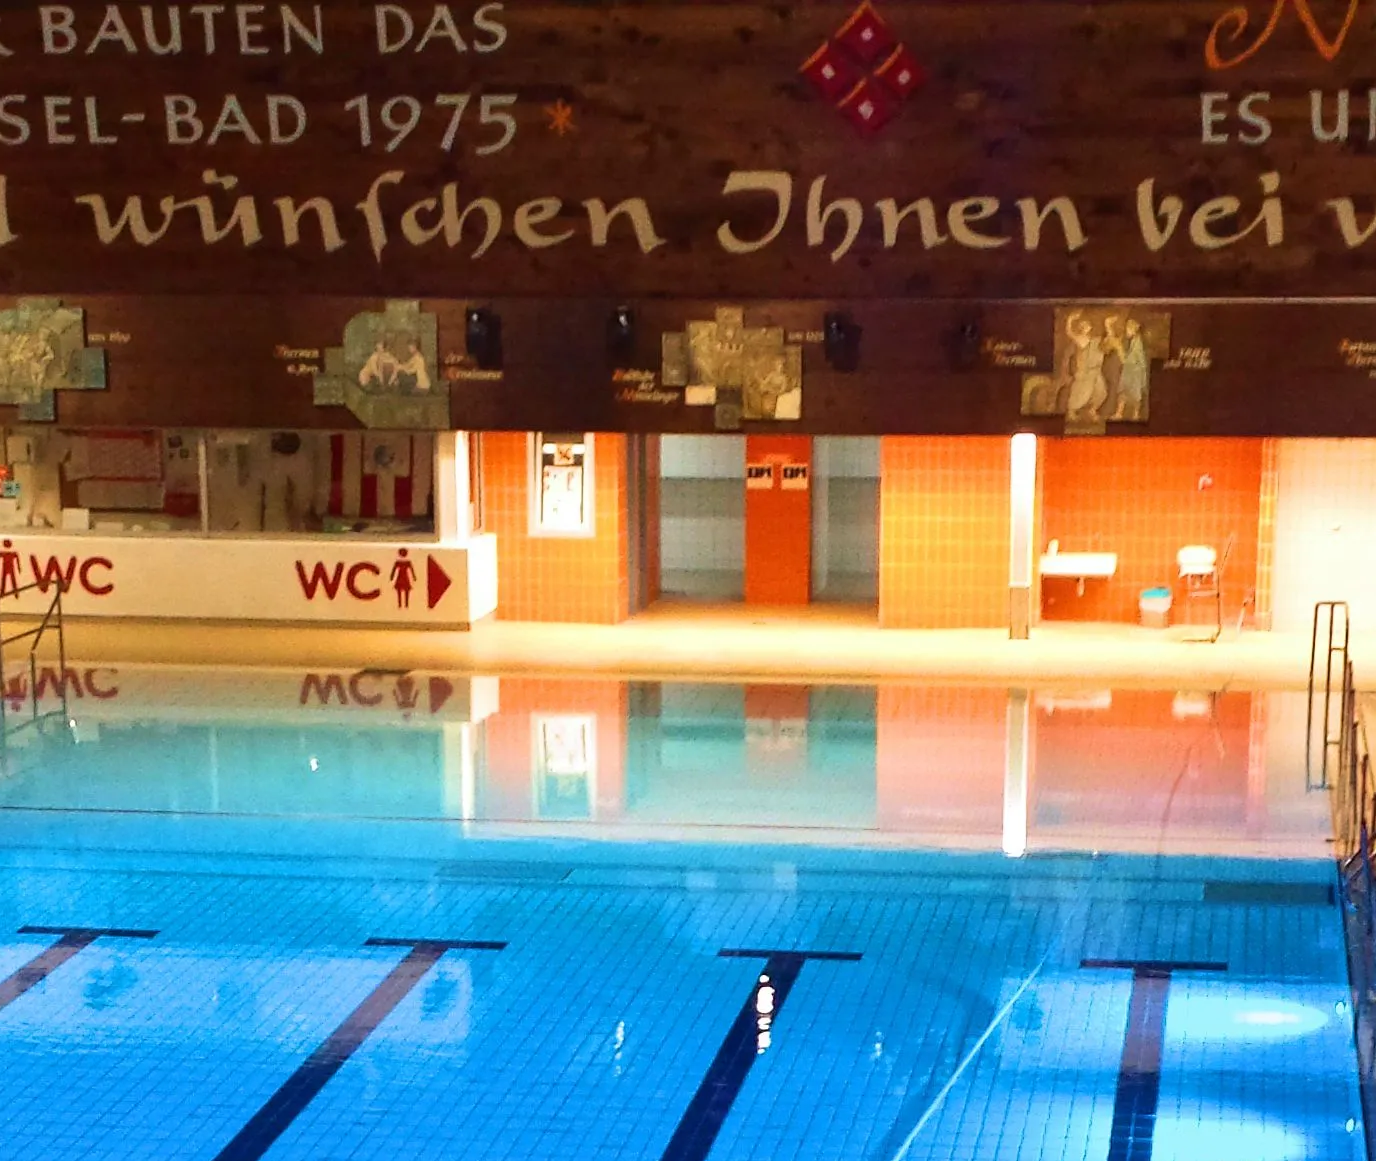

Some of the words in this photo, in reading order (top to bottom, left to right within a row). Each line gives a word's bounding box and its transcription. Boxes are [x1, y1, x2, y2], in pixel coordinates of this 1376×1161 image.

[40, 4, 324, 56] BAUTEN
[375, 3, 509, 54] DAS
[344, 93, 517, 156] 1975
[1200, 91, 1272, 144] ES
[716, 170, 1089, 262] Ihnen
[1136, 171, 1284, 252] bei
[30, 554, 115, 596] WC
[294, 559, 381, 601] WC
